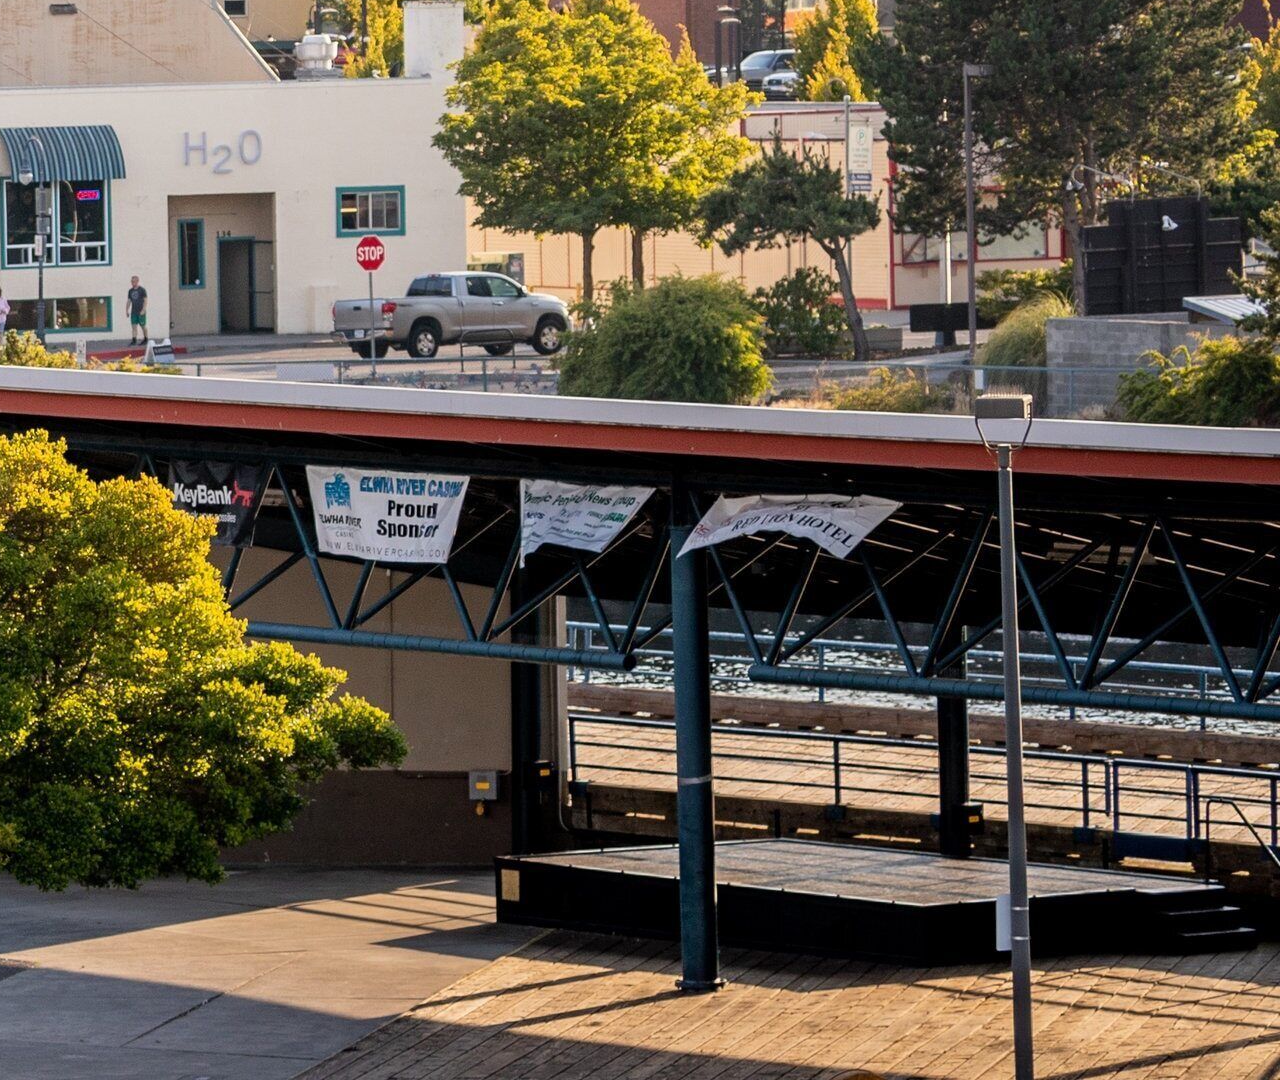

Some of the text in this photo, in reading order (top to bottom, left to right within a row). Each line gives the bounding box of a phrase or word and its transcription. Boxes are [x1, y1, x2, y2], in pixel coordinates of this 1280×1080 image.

[183, 129, 262, 175] H2O
[358, 247, 383, 261] STOP
[173, 482, 232, 508] KeyBank
[360, 476, 394, 495] ELWHA
[396, 478, 426, 497] RIVER
[586, 491, 613, 506] News
[387, 500, 438, 519] Proud
[377, 519, 439, 538] Sponsor
[797, 515, 854, 548] HOTEL
